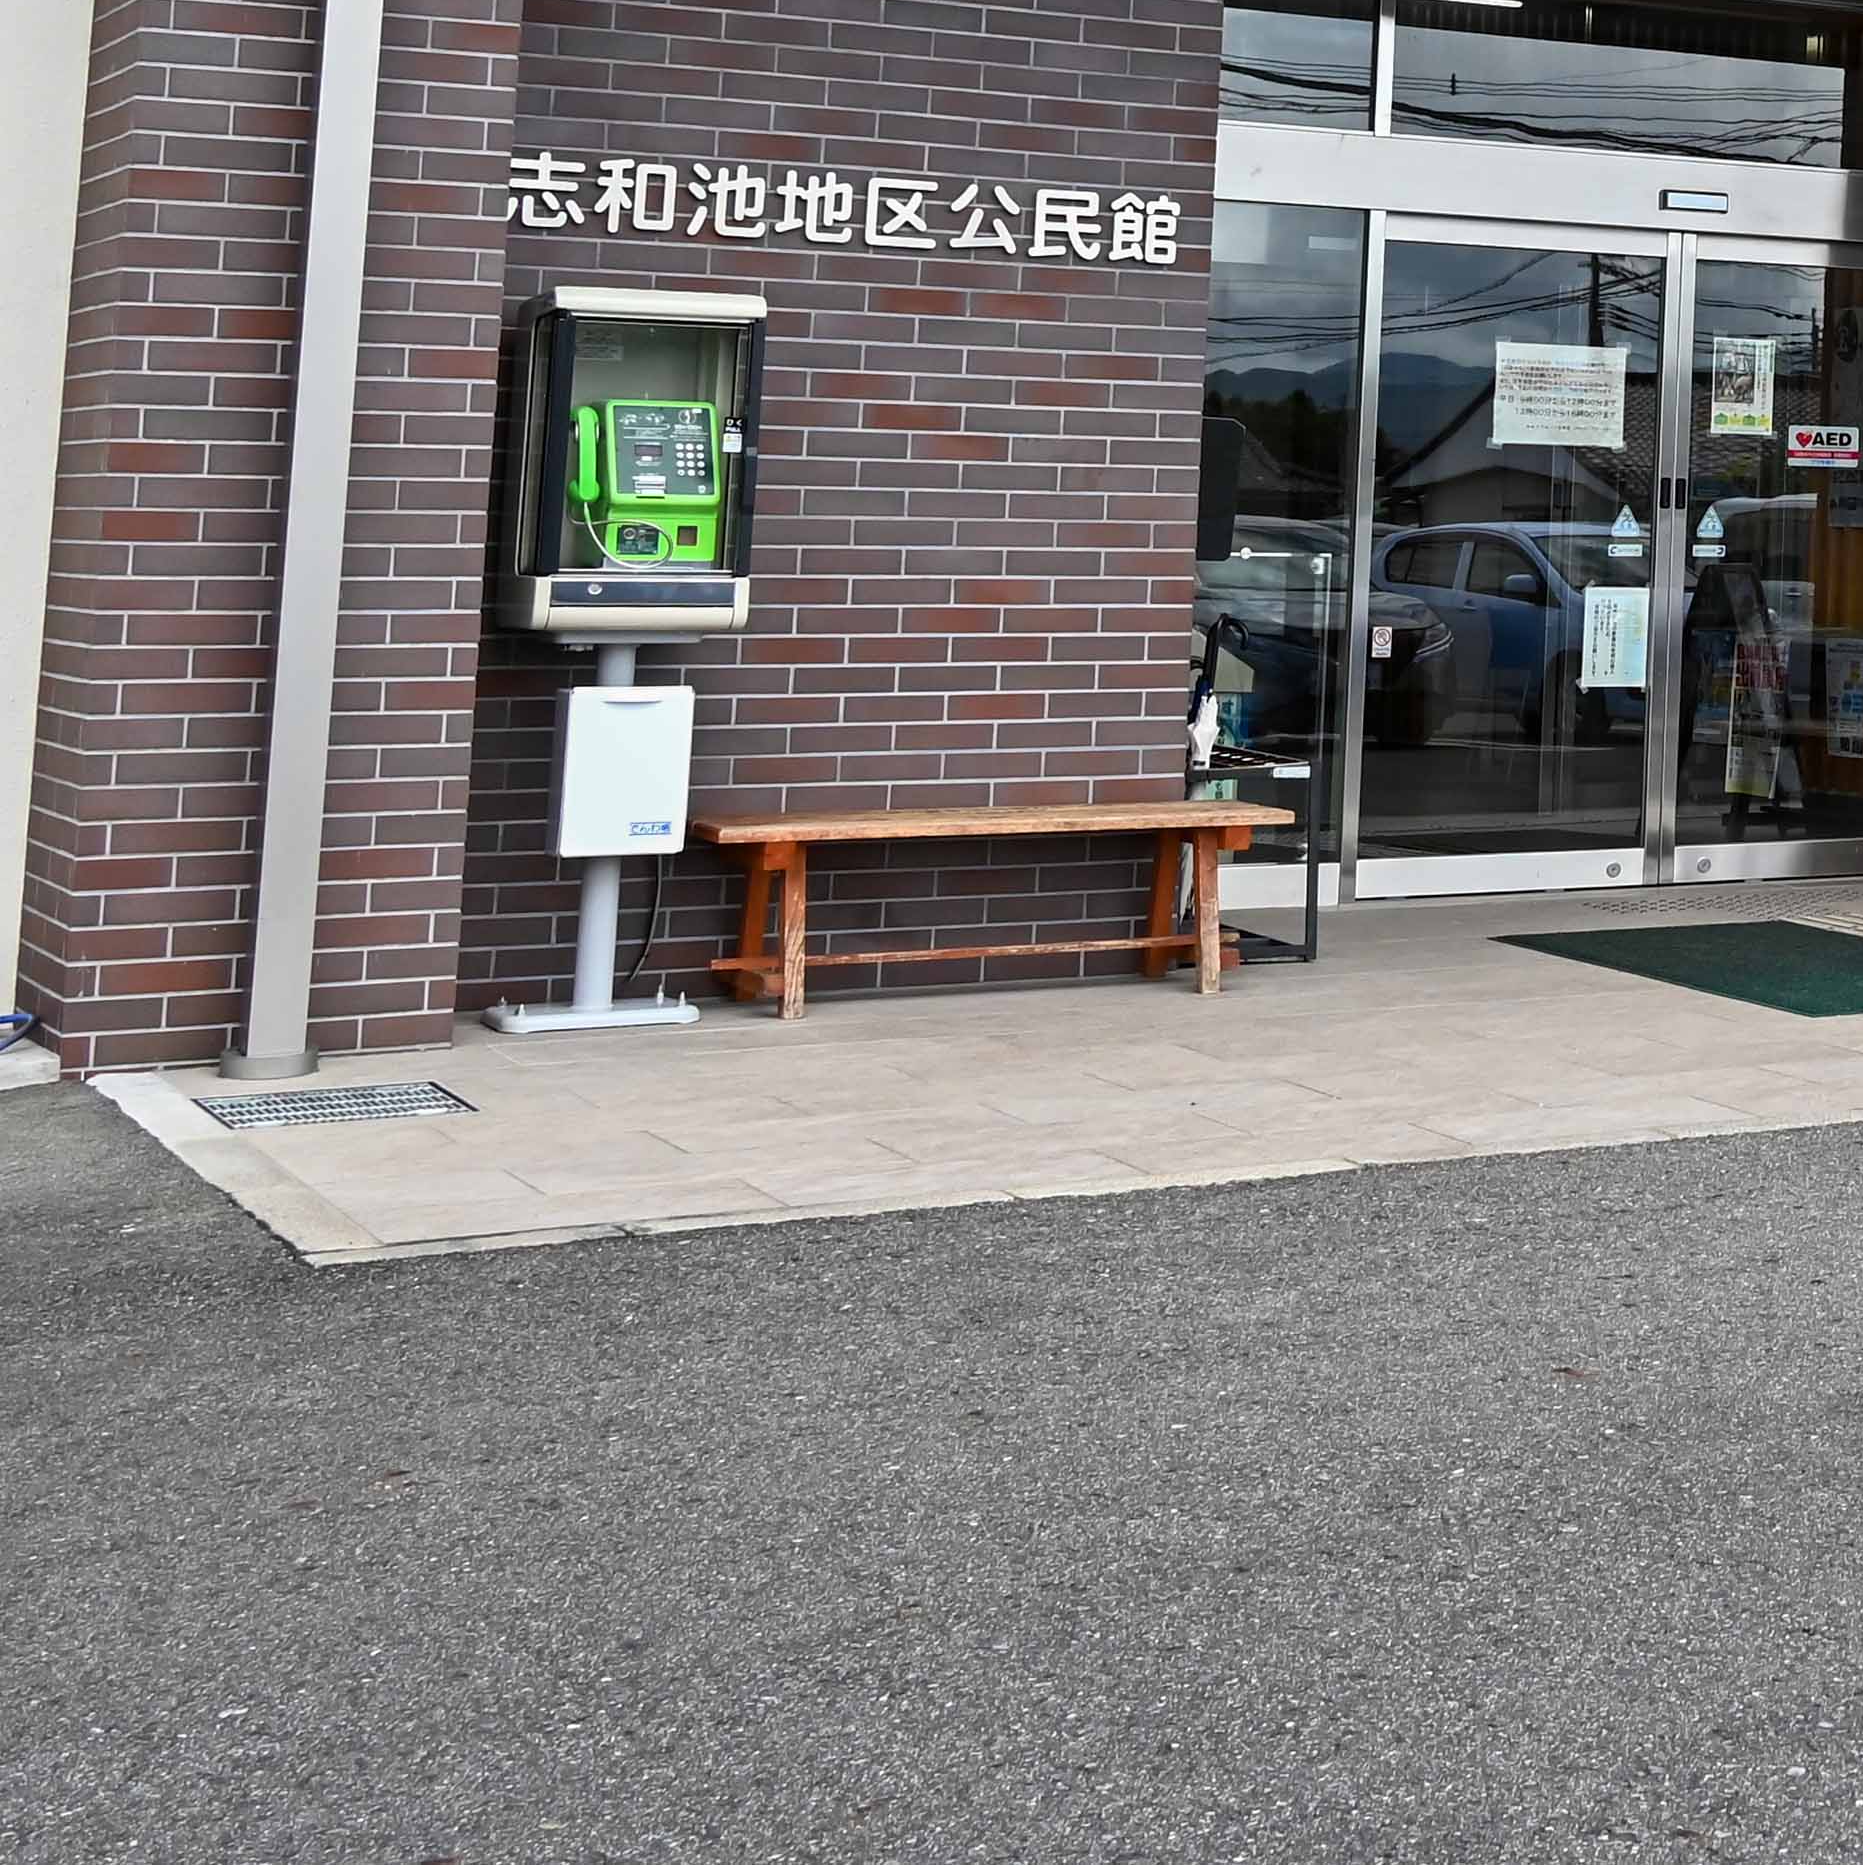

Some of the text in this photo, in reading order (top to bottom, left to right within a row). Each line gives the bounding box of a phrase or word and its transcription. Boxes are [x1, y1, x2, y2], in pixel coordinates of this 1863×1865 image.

[507, 152, 1181, 264] 志和池地区公民館
[1812, 432, 1852, 446] AED
